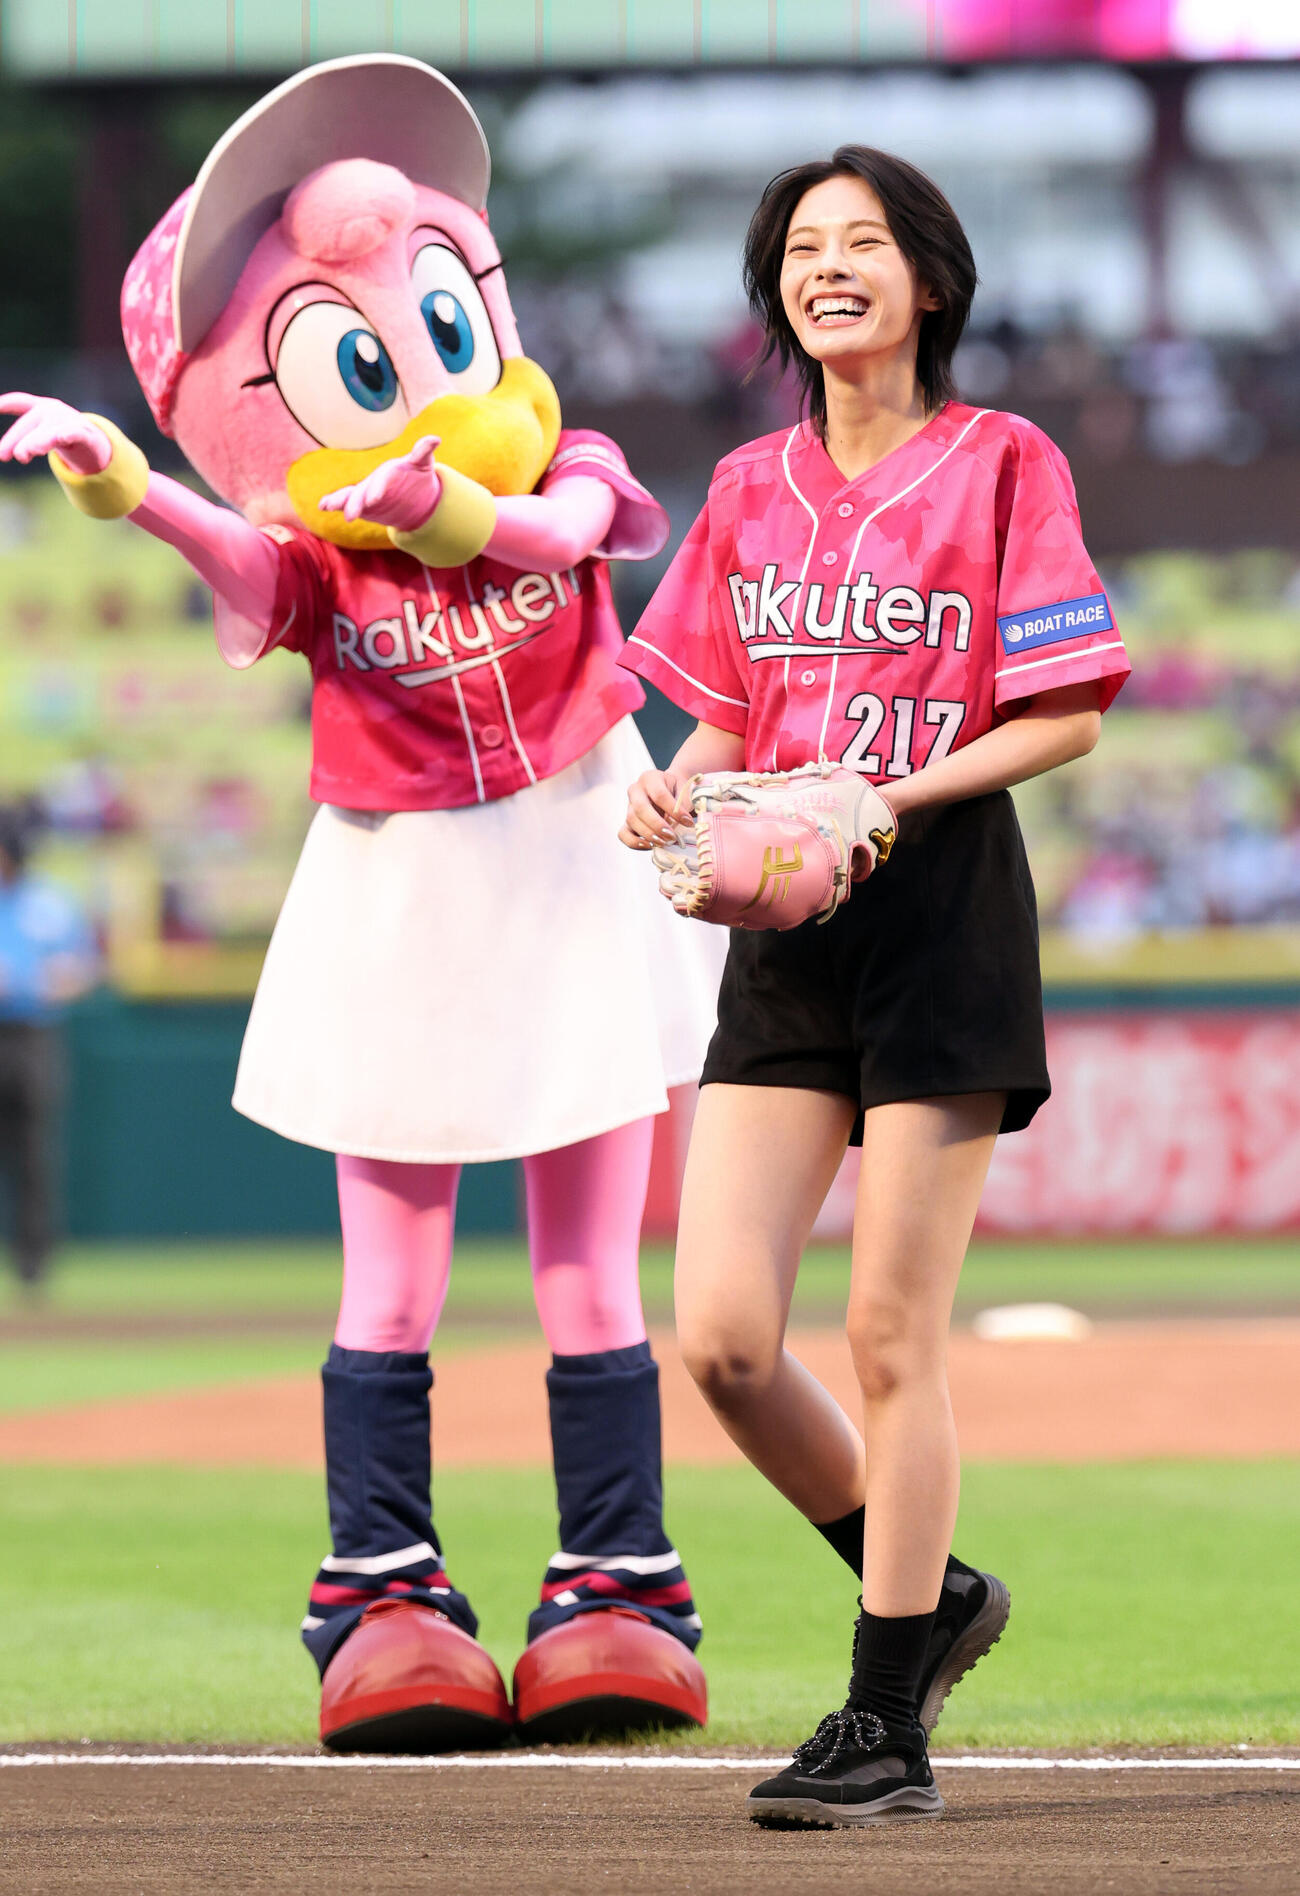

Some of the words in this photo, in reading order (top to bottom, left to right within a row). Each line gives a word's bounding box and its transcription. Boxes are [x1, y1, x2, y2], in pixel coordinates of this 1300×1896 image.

[332, 567, 581, 671] Rakuten
[1024, 613, 1063, 638] BOAT
[1065, 604, 1105, 628] RACE
[839, 691, 966, 778] 217
